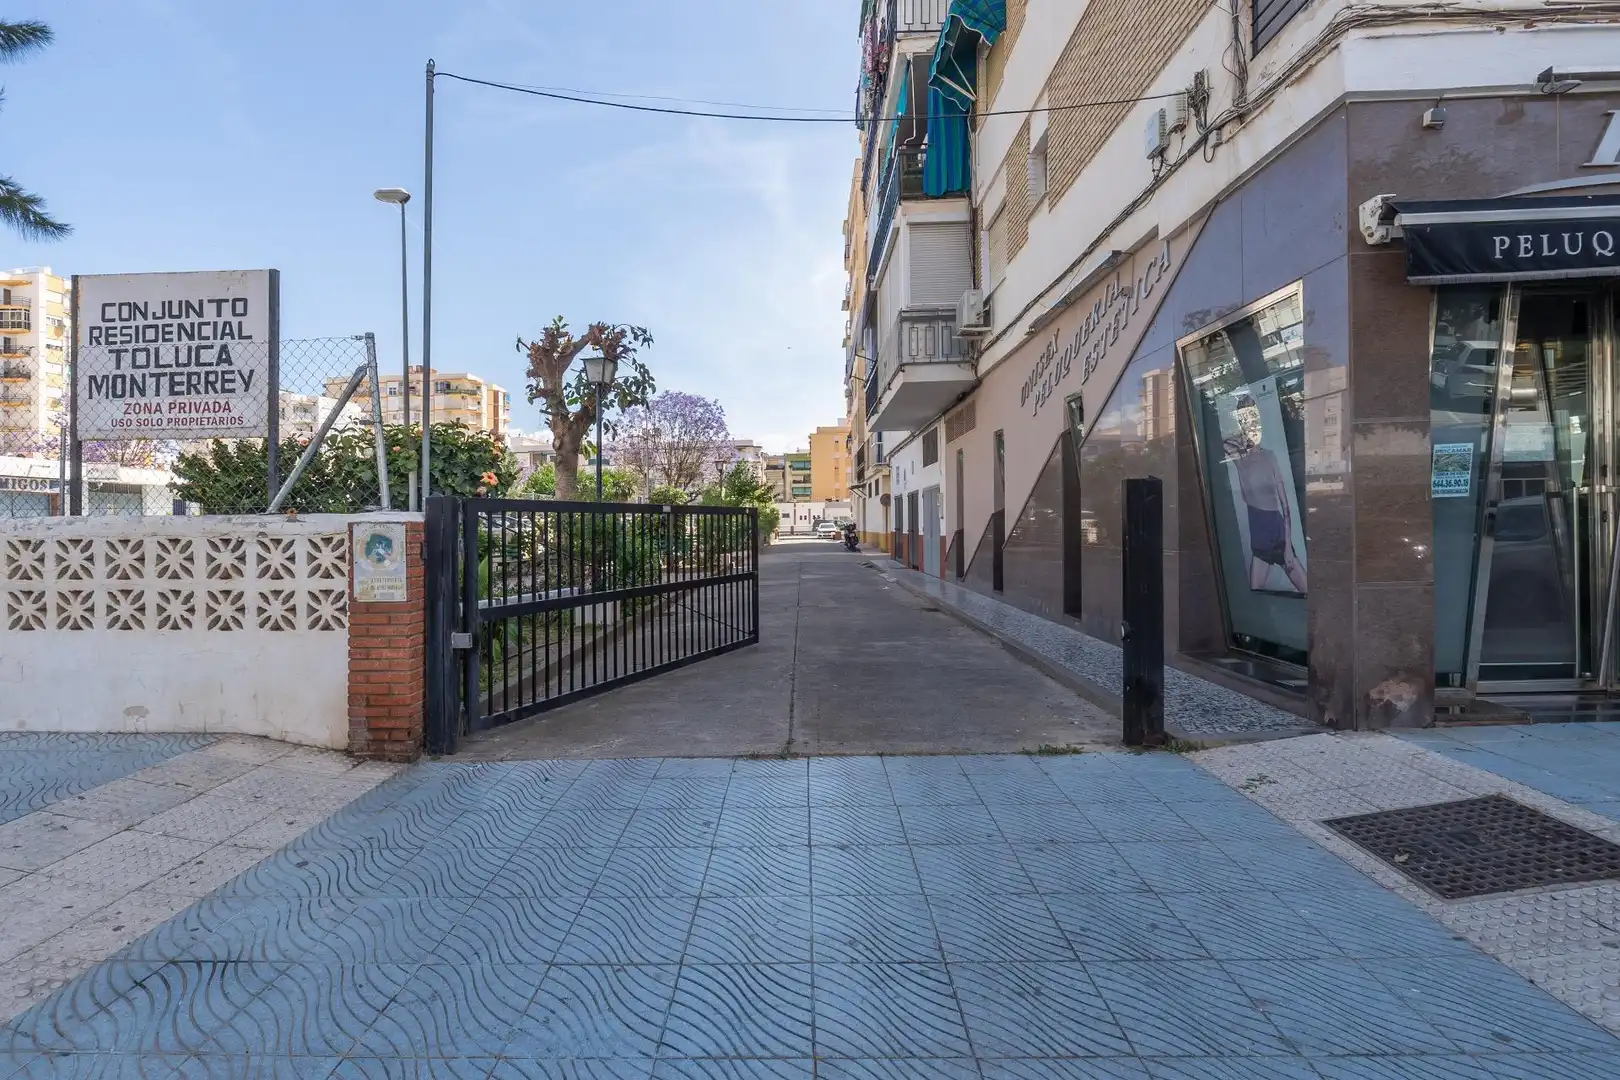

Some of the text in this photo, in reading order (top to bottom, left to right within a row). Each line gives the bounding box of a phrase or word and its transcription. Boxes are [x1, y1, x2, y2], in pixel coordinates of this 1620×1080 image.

[1493, 231, 1615, 259] PELUQ
[101, 298, 248, 323] CONJUNTO
[89, 320, 253, 346] RESIDENCIAL
[108, 344, 234, 370] TOLUCA
[1021, 328, 1060, 408] UNISEX
[88, 369, 255, 400] MONTERREY
[123, 400, 232, 415] ZONA PRIVADA
[111, 416, 244, 427] USO SOLO PROPIETARIOS
